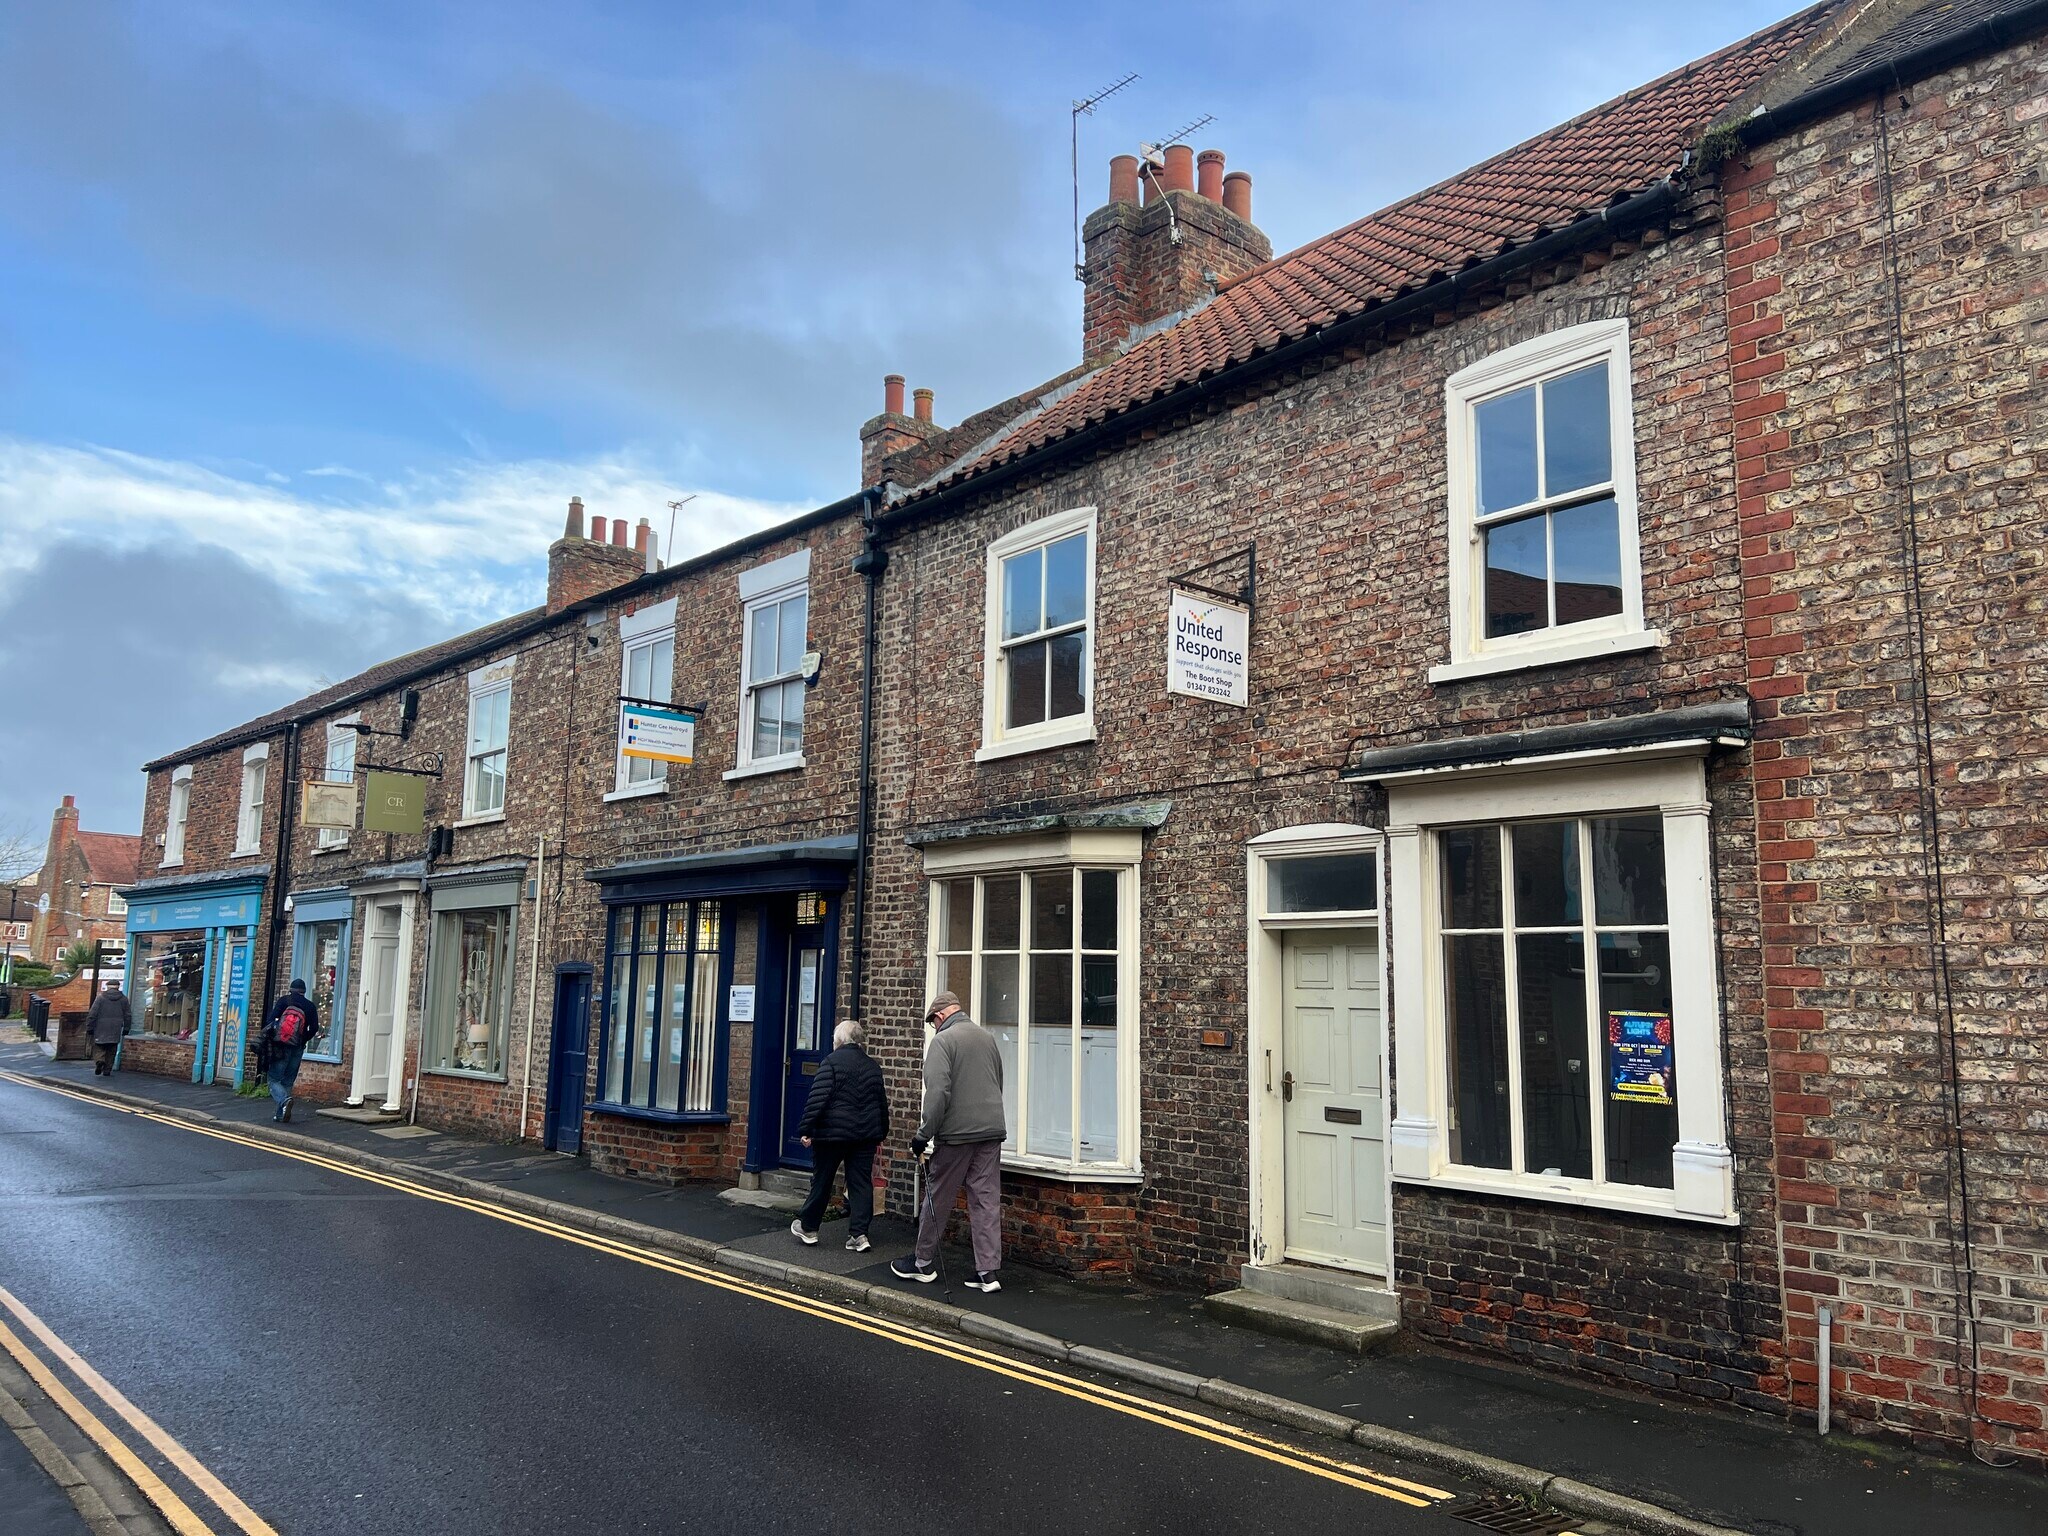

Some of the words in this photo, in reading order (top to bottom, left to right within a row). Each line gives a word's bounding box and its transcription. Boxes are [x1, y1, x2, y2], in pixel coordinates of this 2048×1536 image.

[1178, 616, 1222, 641] United
[1177, 635, 1241, 664] Response
[1205, 665, 1221, 673] changes
[1186, 671, 1197, 679] The
[1199, 674, 1214, 683] Boot
[1216, 678, 1232, 688] Shop
[1187, 682, 1206, 691] 01347
[1208, 687, 1230, 697] 823242
[388, 797, 403, 806] CR
